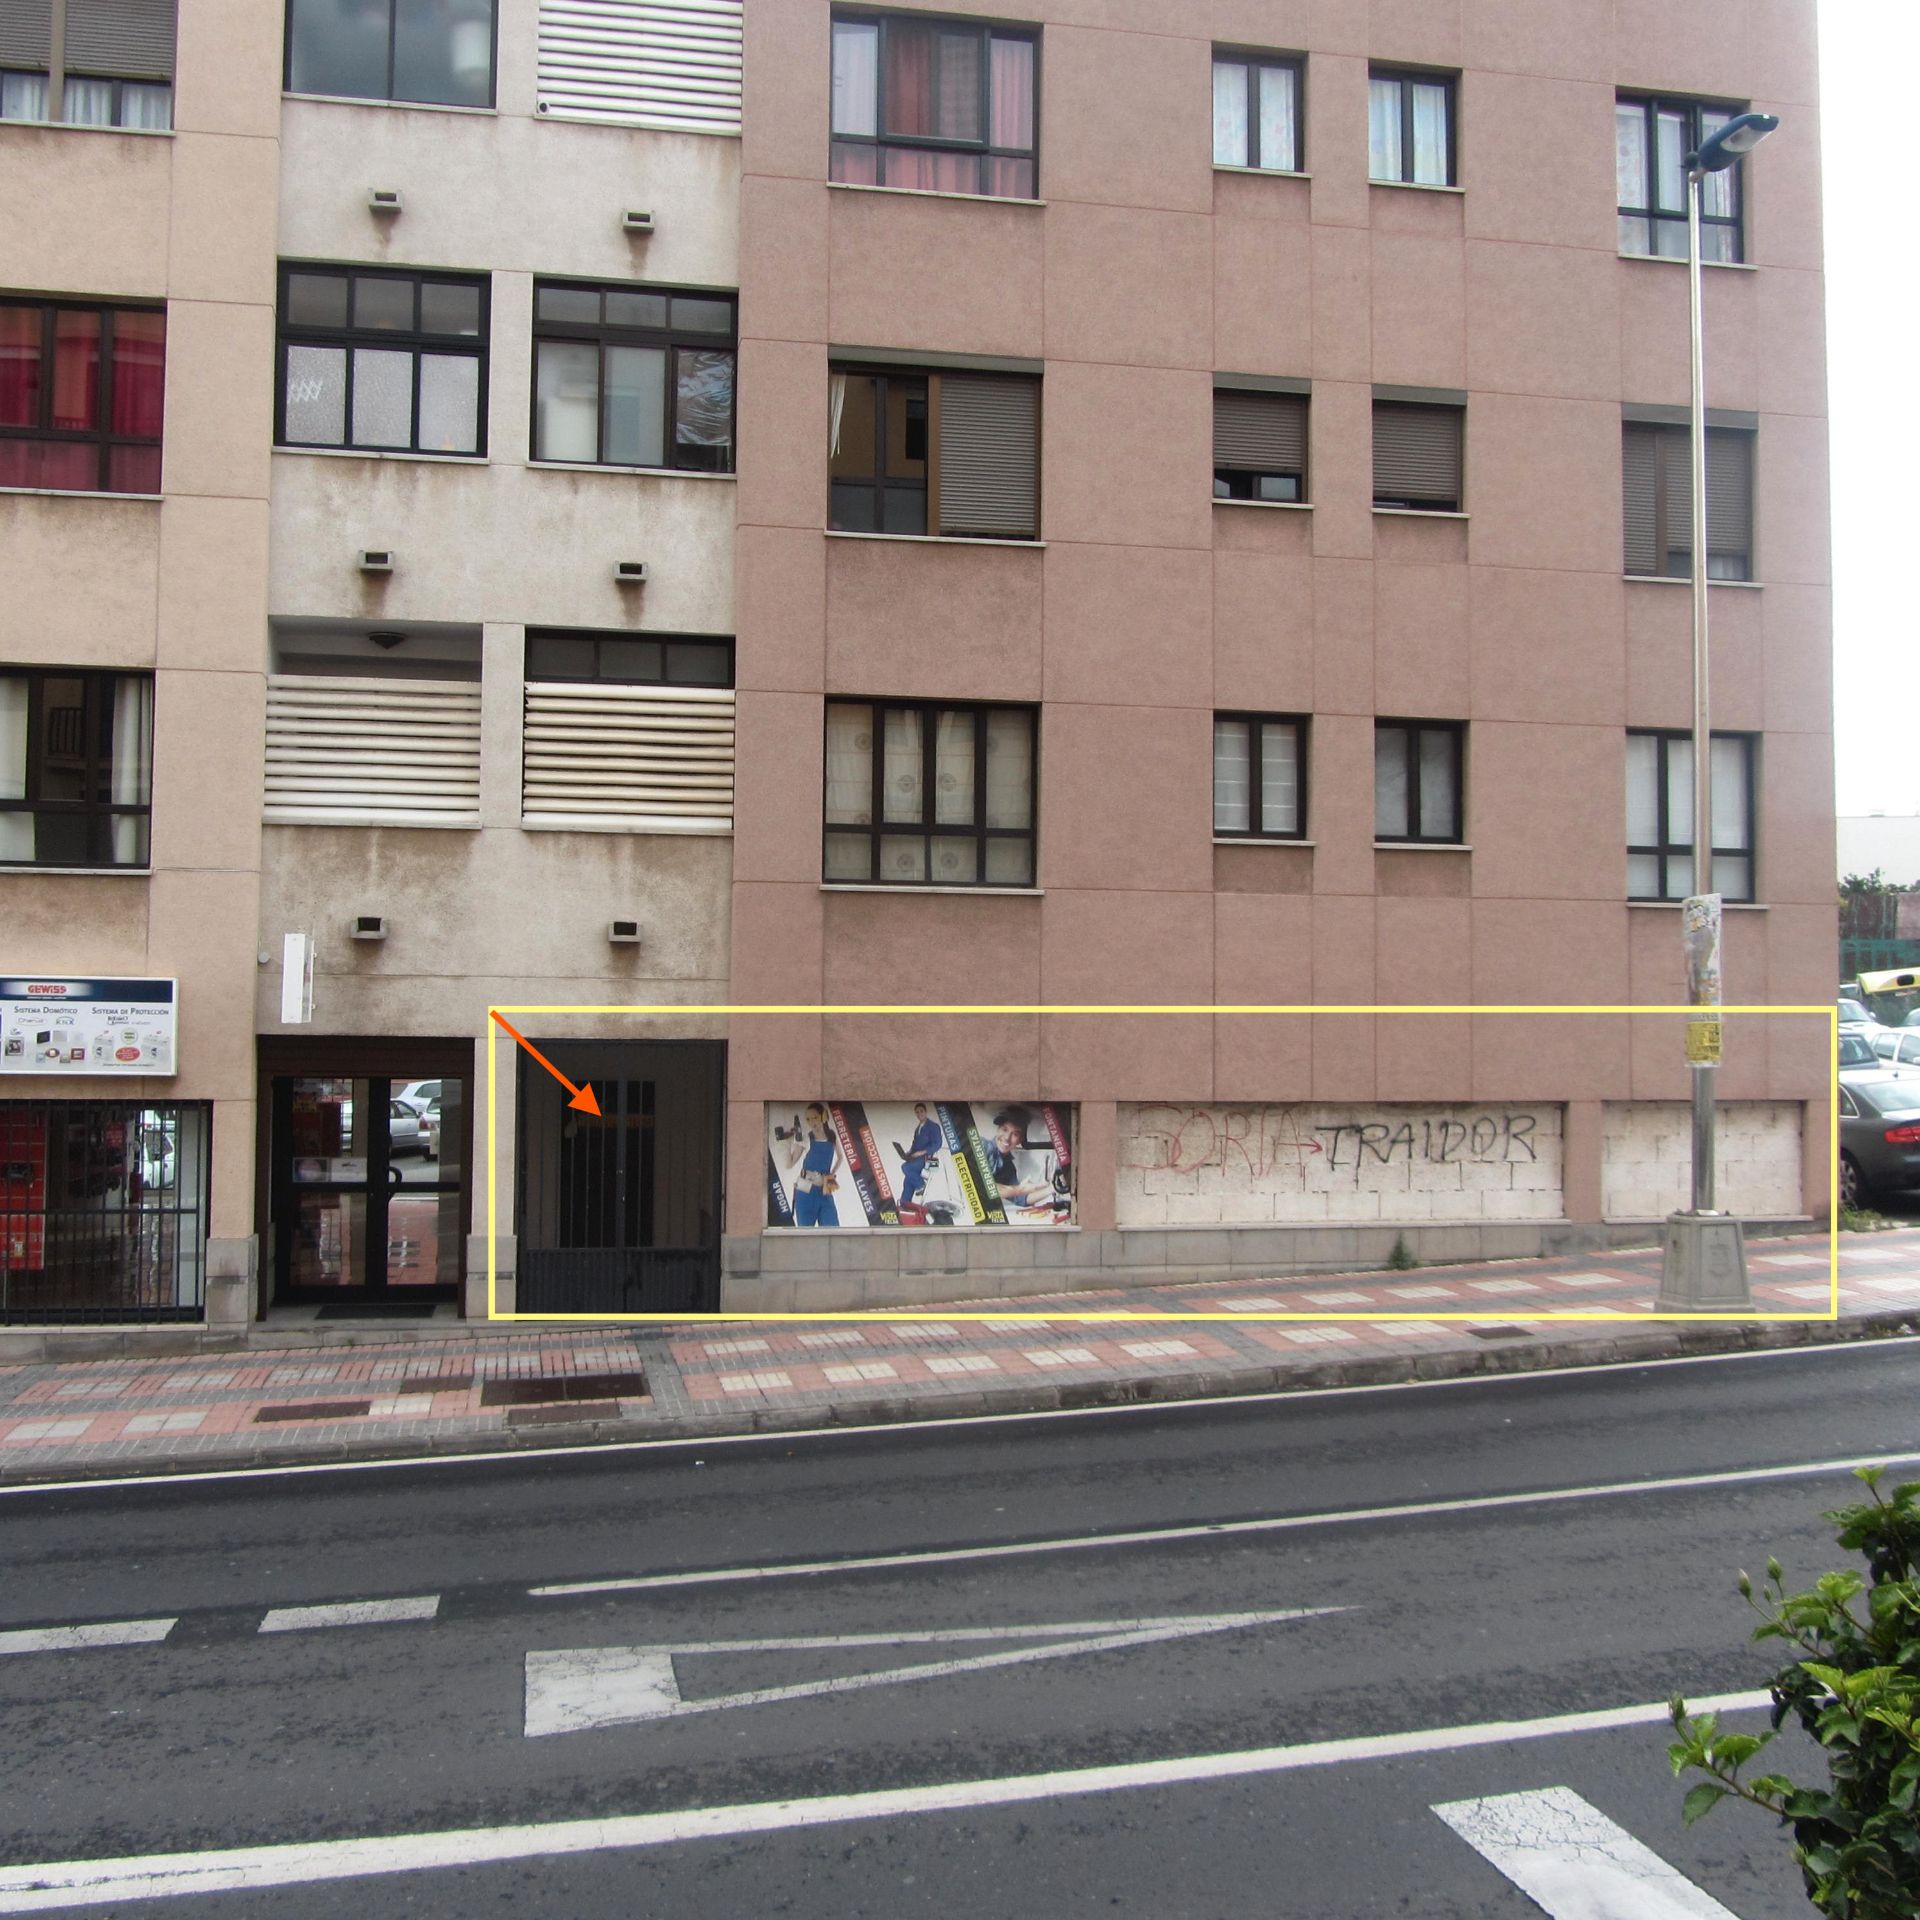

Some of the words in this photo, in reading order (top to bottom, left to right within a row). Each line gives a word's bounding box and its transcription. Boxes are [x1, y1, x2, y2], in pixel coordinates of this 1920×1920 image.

[832, 1109, 857, 1165] FERRETERÍA
[938, 1106, 958, 1151] PINTURAS
[1043, 1107, 1068, 1162] FONTANERÍA
[1315, 1115, 1537, 1171] TRAIDOR
[956, 1156, 981, 1219] ELECTRICIDAD
[969, 1130, 997, 1197] HERRAMIENTAS
[773, 1181, 789, 1213] HOGAR
[857, 1179, 874, 1212] LLAVES
